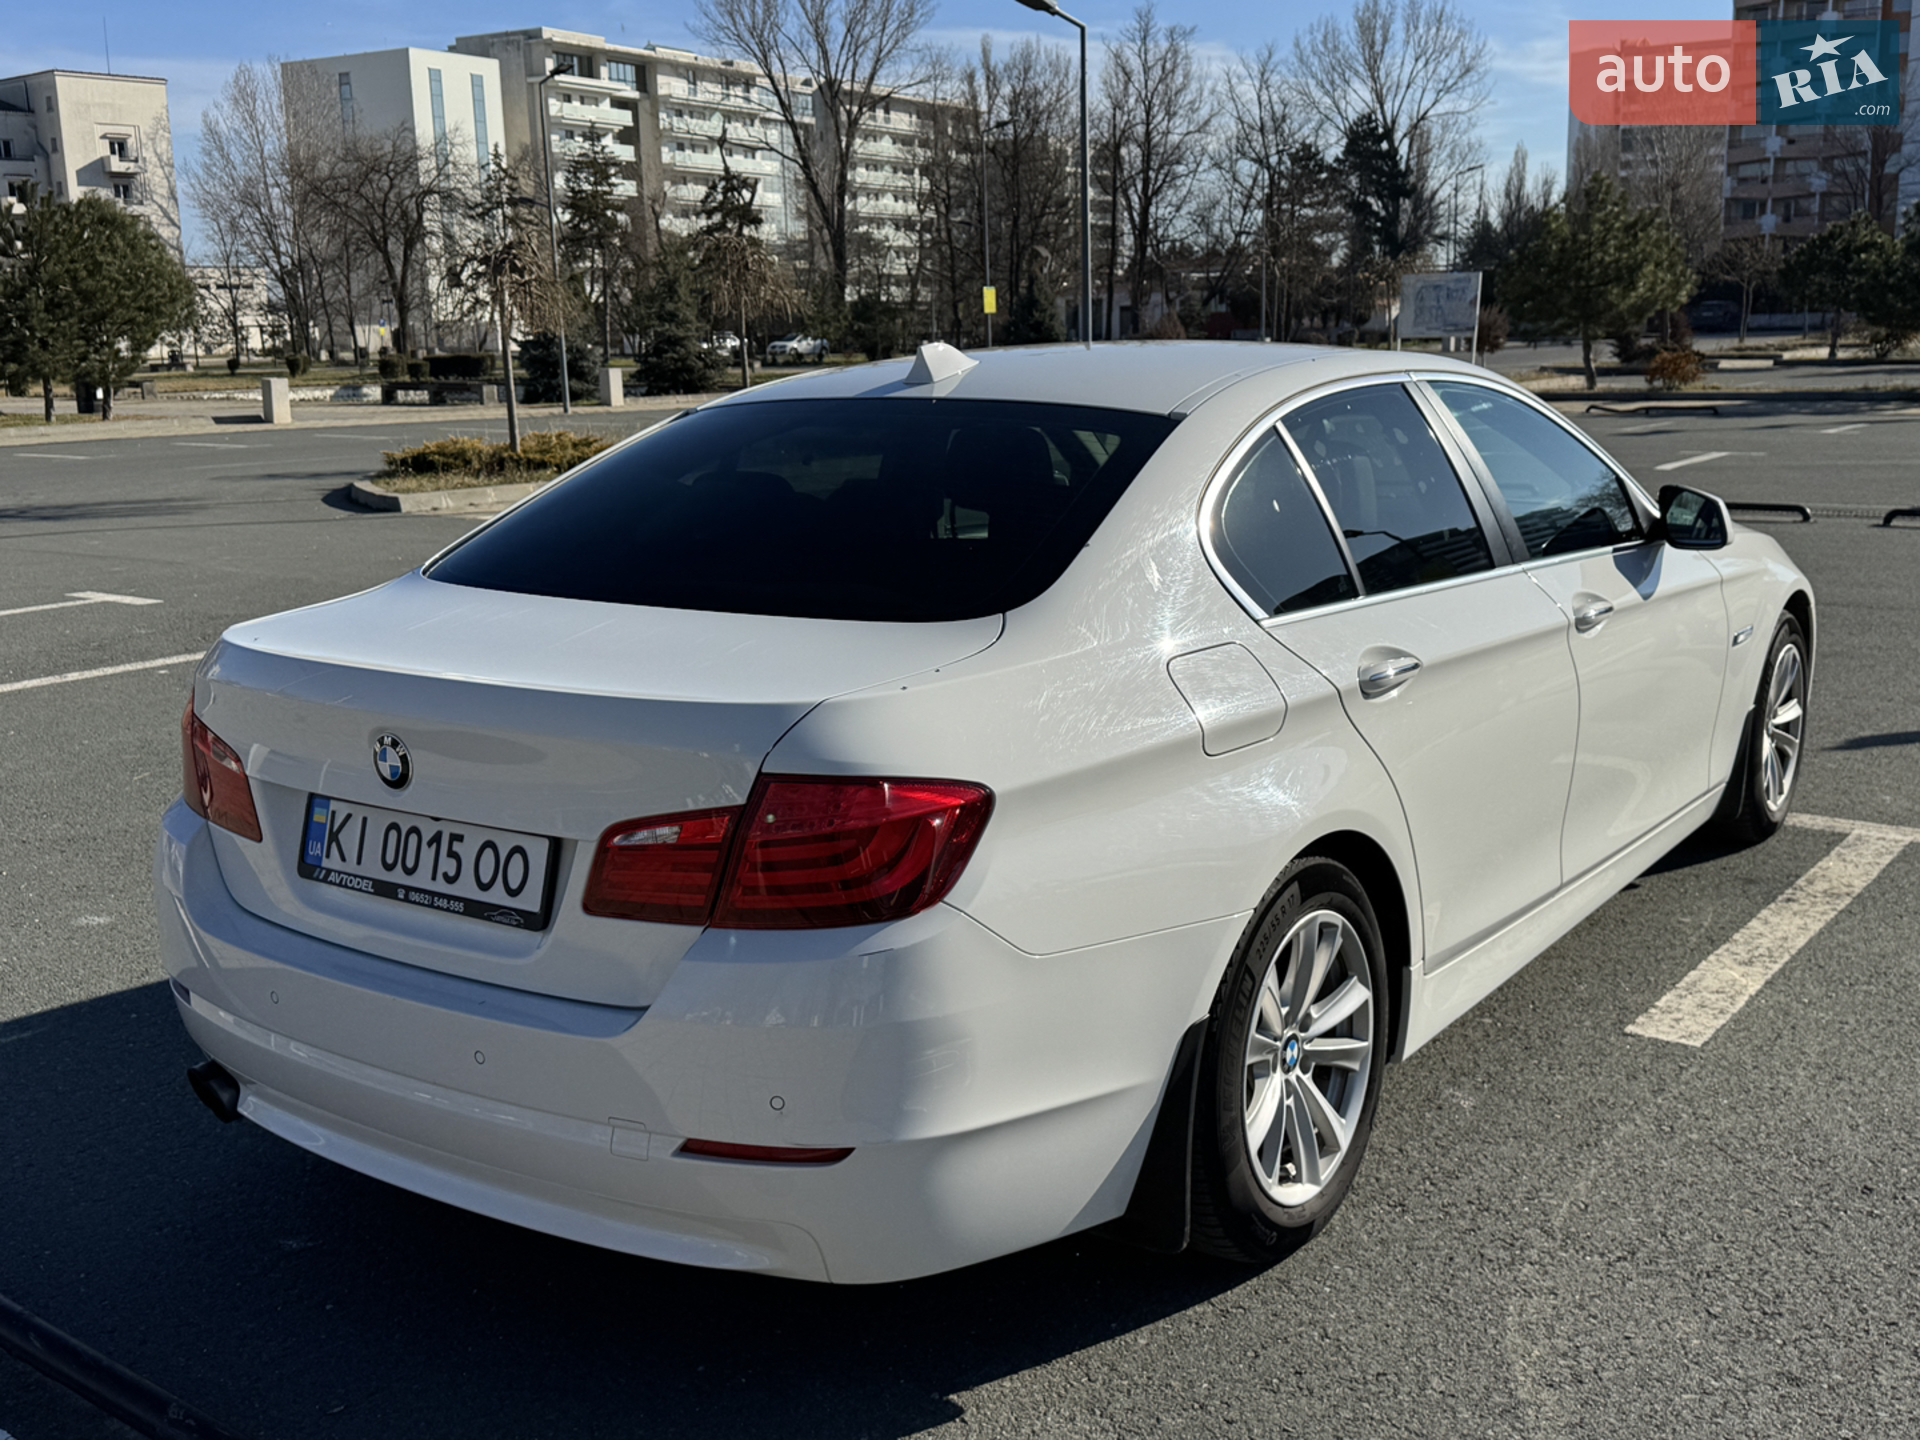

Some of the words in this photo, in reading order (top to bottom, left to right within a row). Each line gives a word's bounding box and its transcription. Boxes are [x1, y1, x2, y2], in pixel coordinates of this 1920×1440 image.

[374, 735, 406, 756] BMW
[308, 840, 321, 856] UA
[325, 810, 368, 866] KI
[381, 822, 464, 885] 0015
[327, 873, 374, 893] AVTODEL
[1256, 913, 1280, 961] 225/55
[1280, 904, 1287, 918] R
[1287, 894, 1295, 908] 17
[1223, 972, 1254, 1112] MICHELIN
